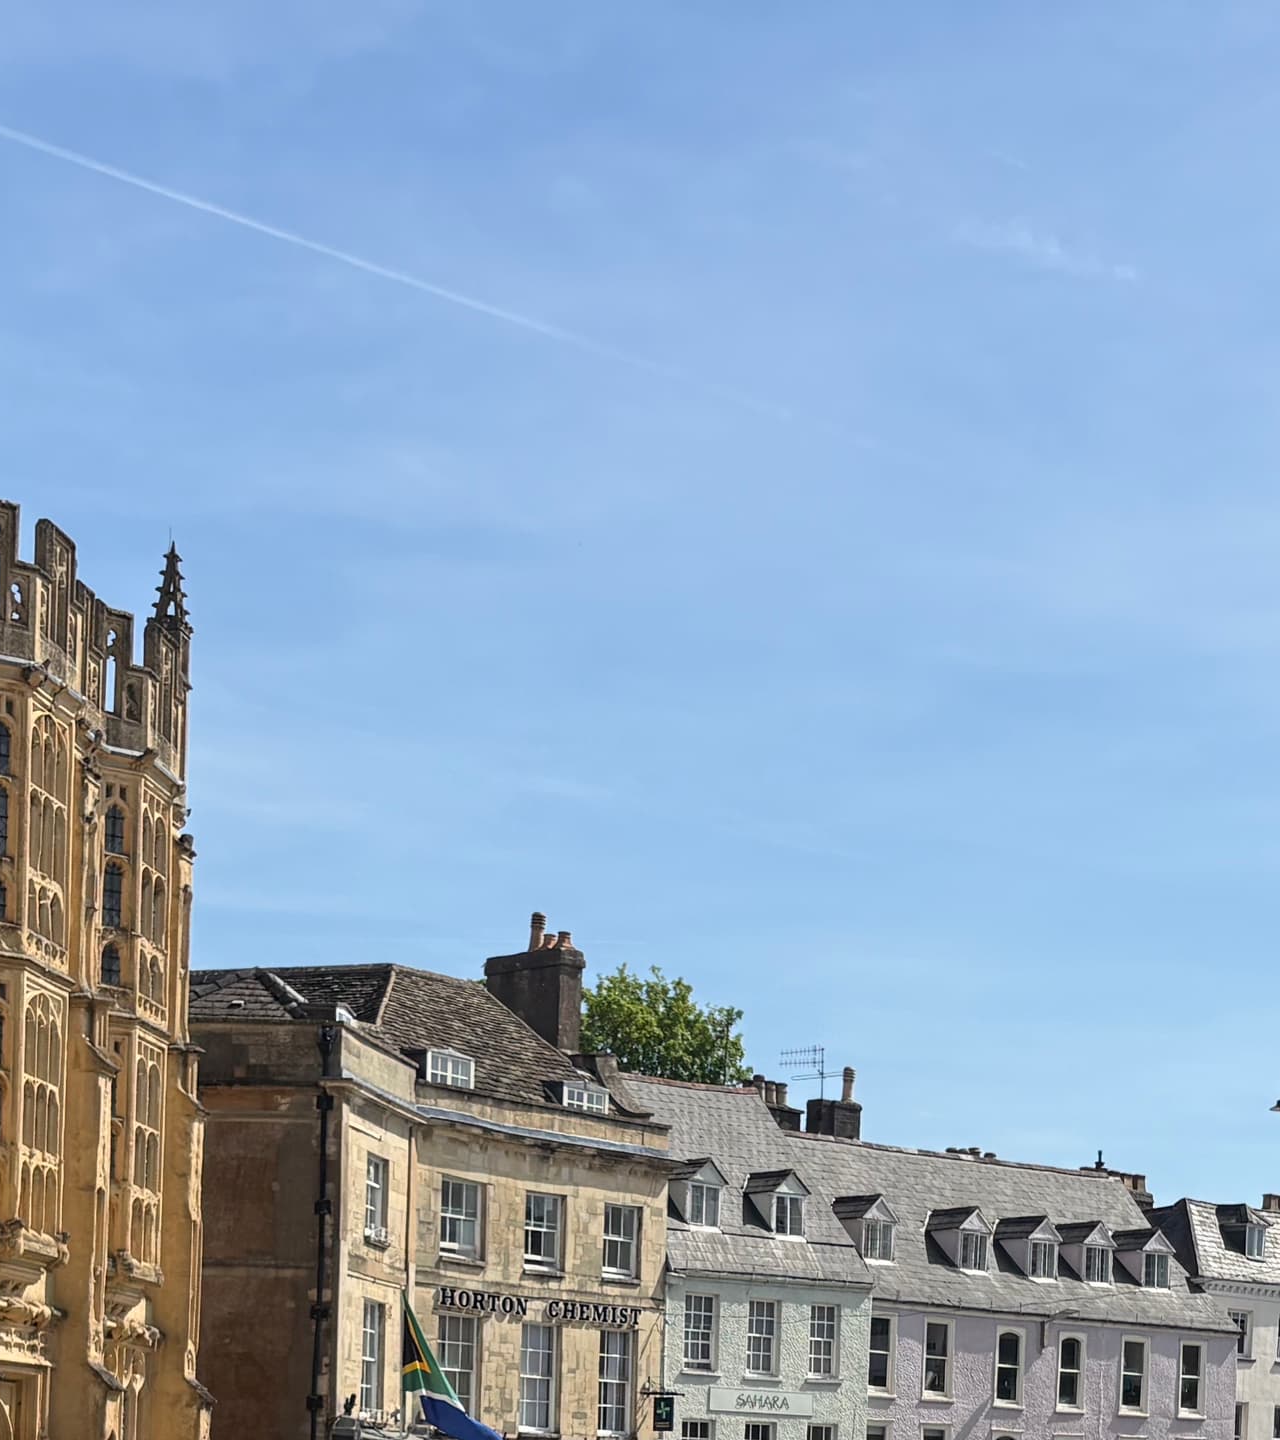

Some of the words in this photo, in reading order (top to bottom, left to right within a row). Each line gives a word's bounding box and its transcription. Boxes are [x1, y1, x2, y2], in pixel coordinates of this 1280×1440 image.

[439, 1287, 529, 1316] HORTON
[548, 1301, 641, 1325] CHEMIST
[736, 1392, 790, 1410] SAHARA
